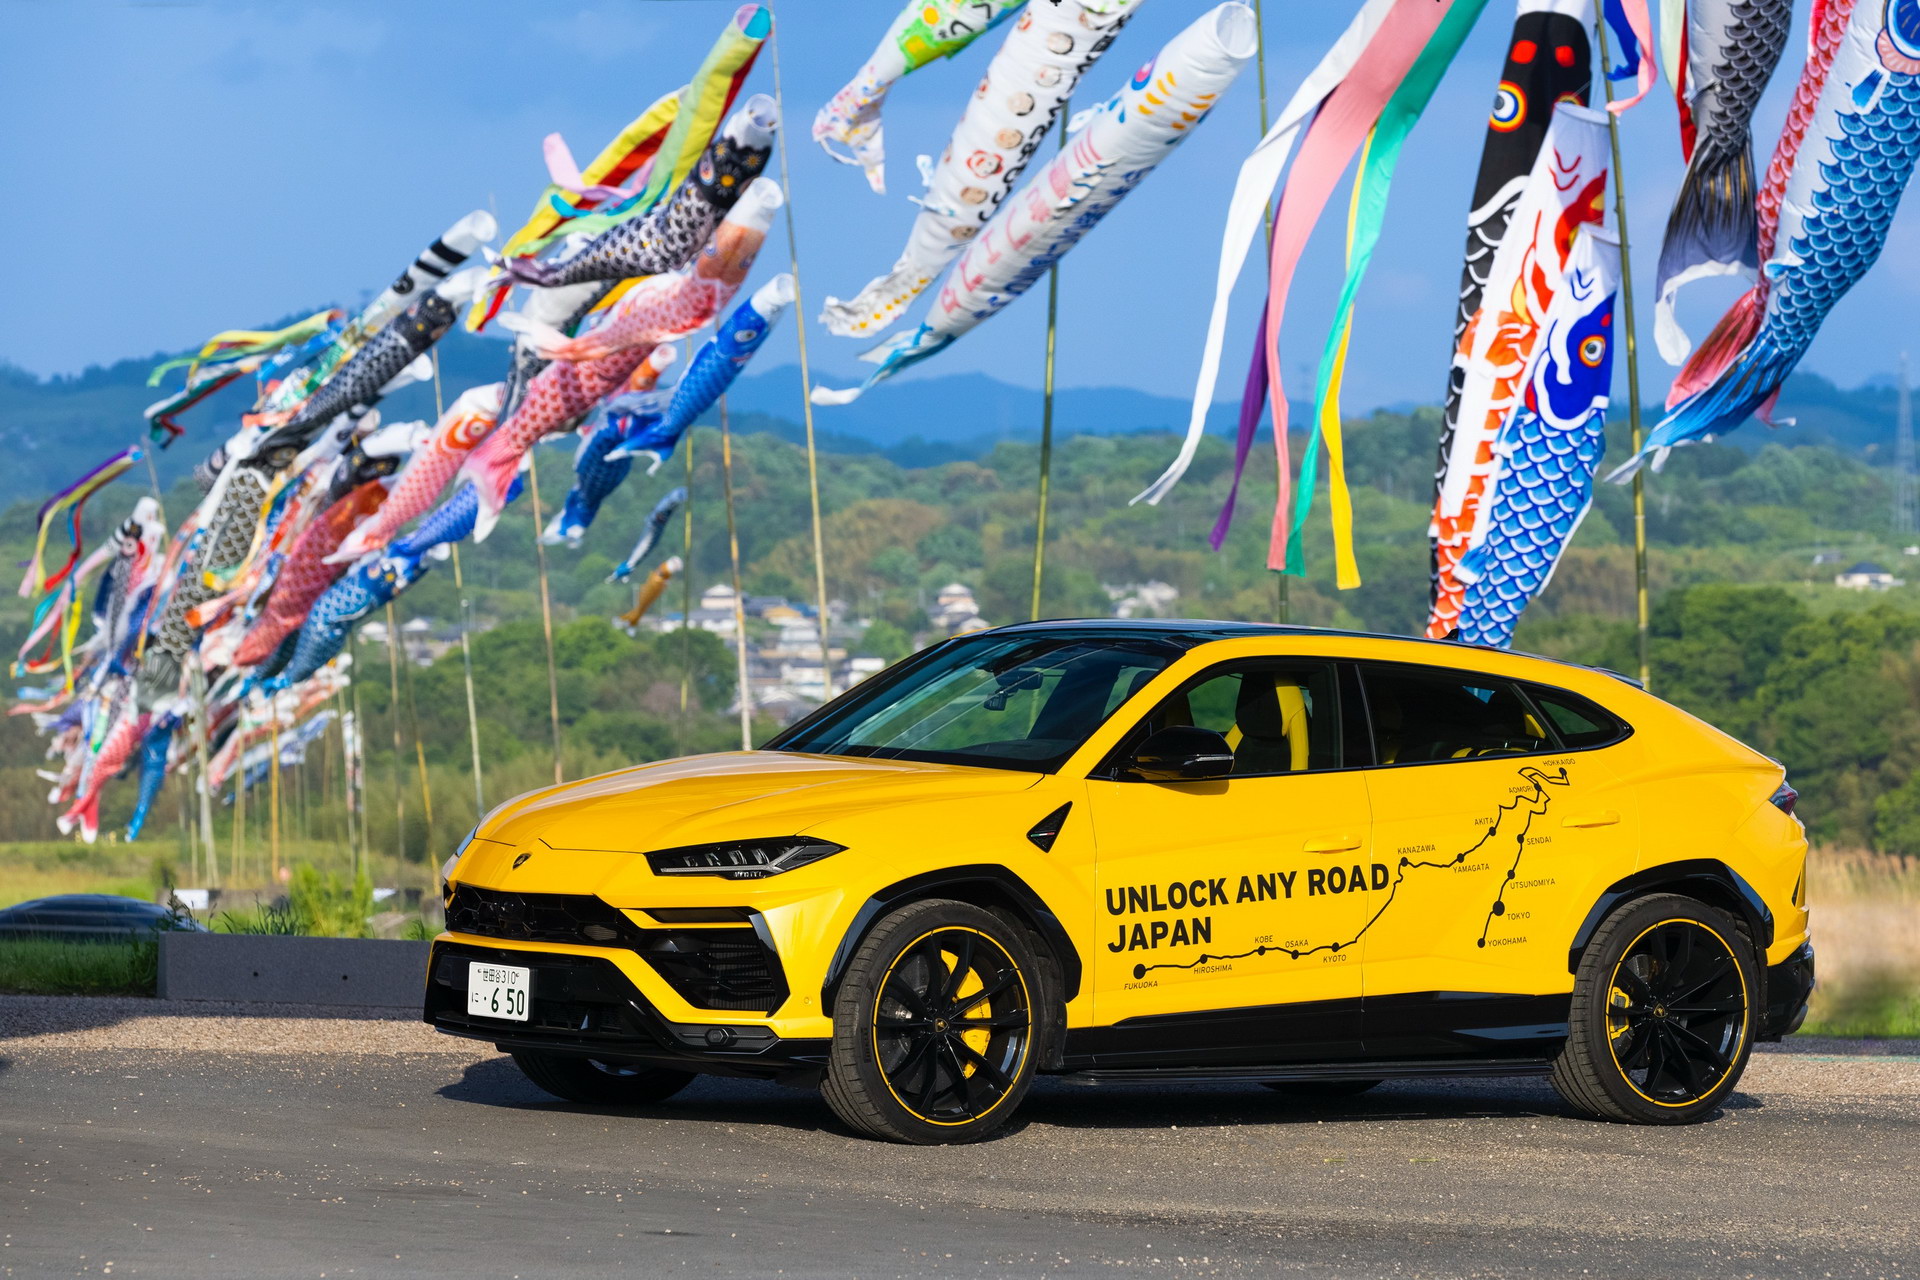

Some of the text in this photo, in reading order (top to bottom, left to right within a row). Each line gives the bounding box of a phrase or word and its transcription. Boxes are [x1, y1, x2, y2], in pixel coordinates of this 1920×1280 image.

[1508, 785, 1534, 794] AOMORI
[1474, 817, 1494, 826] AKITA
[1526, 836, 1552, 845] SENDAI
[1397, 844, 1436, 855] KANAZAWA
[1453, 863, 1490, 873] YAMAGATA
[1510, 878, 1556, 889] UTSUNOMIYA
[1105, 863, 1390, 916] UNLOCK ANY ROAD
[1507, 911, 1531, 921] TOKYO
[1107, 917, 1212, 953] JAPAN
[1254, 935, 1273, 944] KOBE
[1285, 938, 1309, 948] OSAKA
[1487, 936, 1527, 947] YOKOHAMA
[1323, 954, 1347, 963] KYOTO
[1194, 963, 1233, 975] HIROSHIMA
[1124, 980, 1158, 990] FUKUOKA
